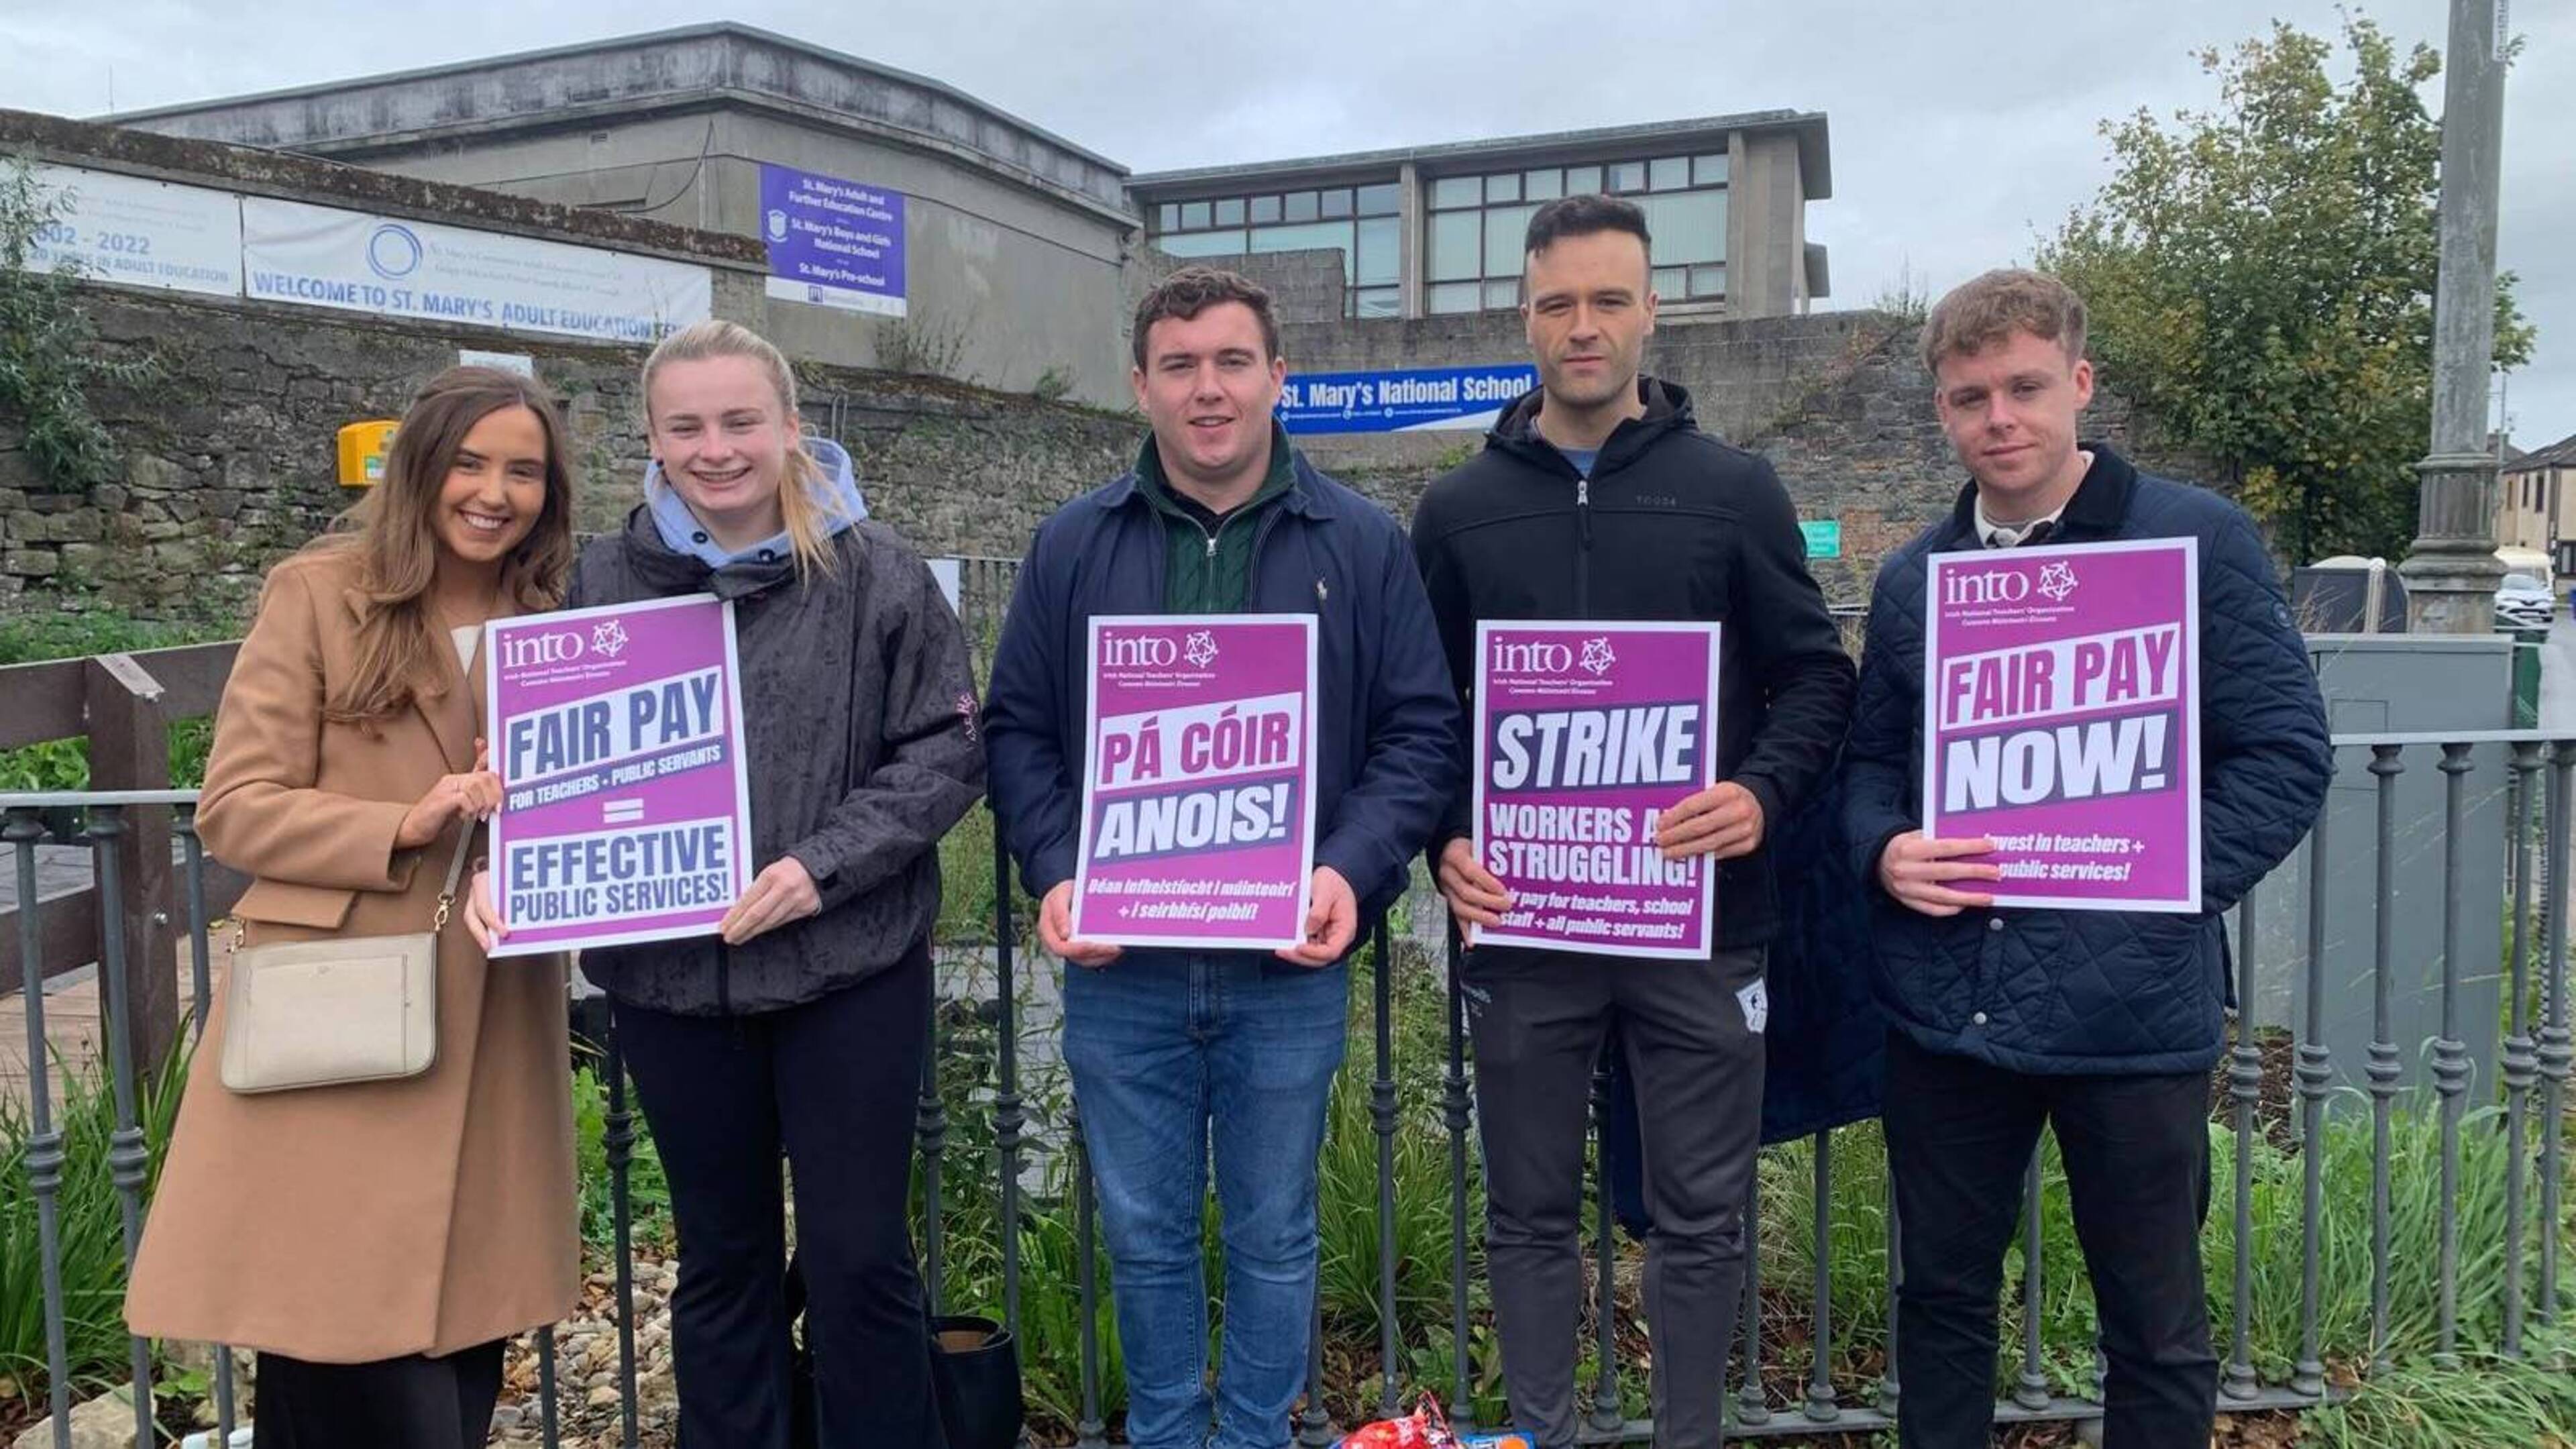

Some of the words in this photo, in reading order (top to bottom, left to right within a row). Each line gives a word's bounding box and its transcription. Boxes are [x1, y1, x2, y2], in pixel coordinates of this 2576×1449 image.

[98, 231, 150, 255] 2022
[254, 272, 356, 303] WELCOME
[362, 286, 386, 307] TO
[392, 289, 418, 311] ST.
[423, 294, 493, 319] MARY'S
[502, 303, 554, 325] ADULT
[561, 311, 650, 338] EDUCATION
[1281, 385, 1304, 408] St.
[1309, 382, 1374, 410] Mary's
[1379, 378, 1457, 404] National
[1463, 374, 1532, 400] School
[1945, 568, 2029, 604] into
[502, 633, 584, 669] into
[1103, 631, 1177, 666] into
[1493, 637, 1572, 672] into
[1947, 649, 2054, 724] FAIR
[2074, 630, 2175, 706] PAY
[510, 700, 610, 780] FAIR
[629, 674, 718, 751] PAY
[1102, 716, 1161, 784] PÁ
[1180, 704, 1290, 773] CÓIR
[1493, 705, 1699, 789] STRIKE
[510, 791, 533, 811] FOR
[536, 774, 599, 804] TEACHERS
[612, 761, 655, 786] PUBLIC
[657, 745, 721, 774] SERVANTS
[1945, 714, 2167, 812] NOW!
[1094, 784, 1289, 859] ANOIS!
[1489, 803, 1632, 843] WORKERS
[2035, 833, 2051, 851] in
[2054, 834, 2130, 853] teachers
[512, 824, 726, 891] EFFECTIVE
[1489, 841, 1697, 887] STRUGGLING!
[2050, 861, 2131, 881] services!
[511, 888, 597, 924] PUBLIC
[606, 872, 729, 914] SERVICES!
[1519, 892, 1548, 909] pay
[1548, 892, 1571, 908] for
[1571, 894, 1640, 914] teachers,
[1643, 898, 1694, 914] school
[1546, 916, 1567, 931] all
[1565, 917, 1611, 934] public
[1612, 922, 1685, 938] servants!
